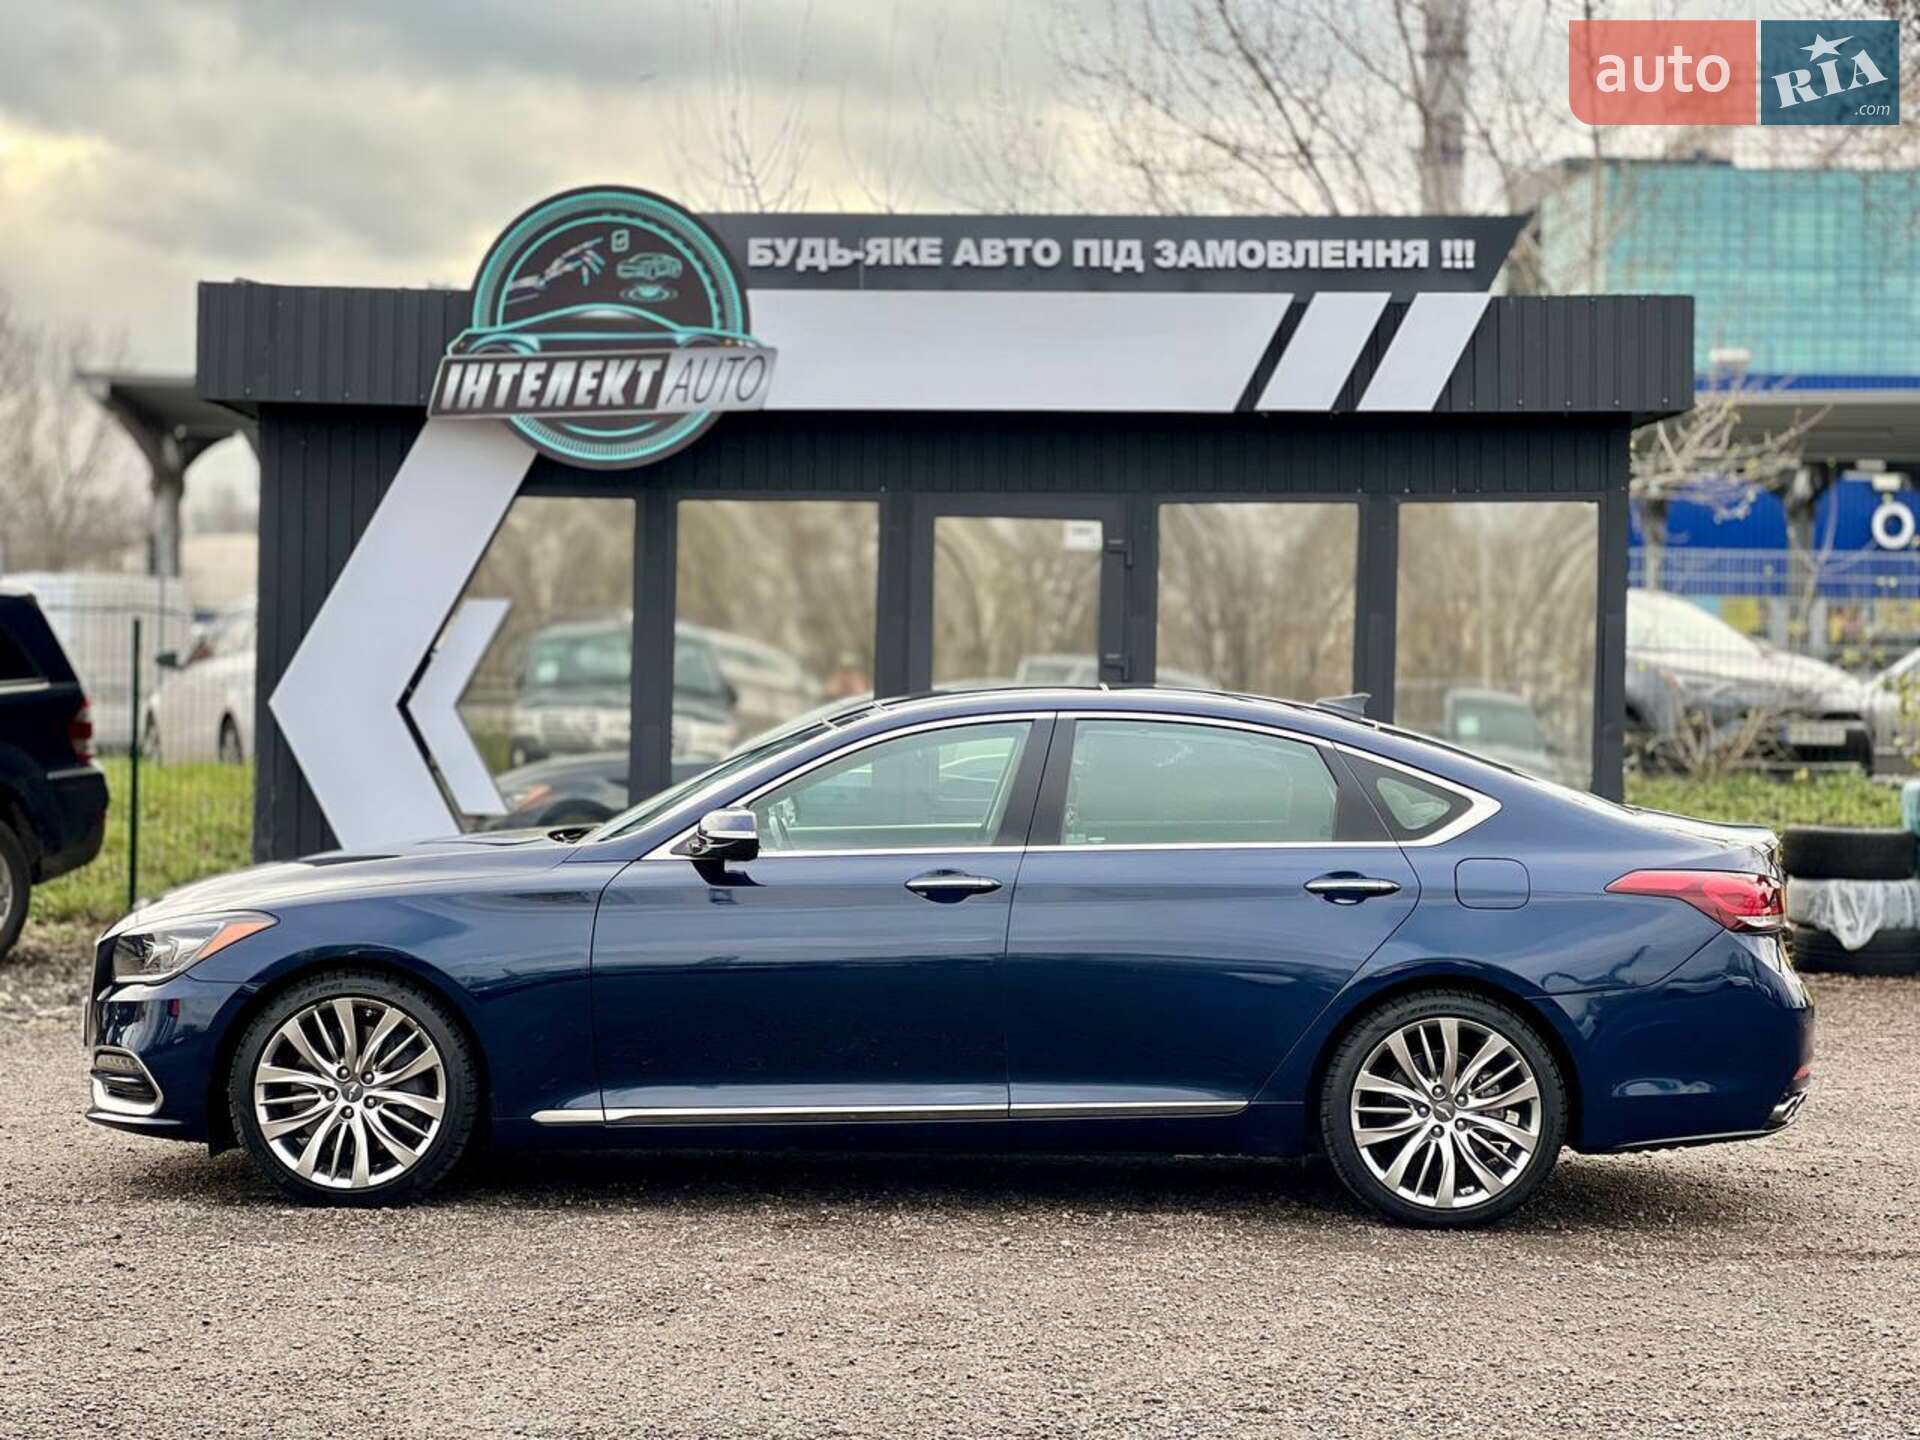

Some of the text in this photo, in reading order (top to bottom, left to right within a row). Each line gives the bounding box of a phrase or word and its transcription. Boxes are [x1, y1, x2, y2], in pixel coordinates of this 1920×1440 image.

[747, 236, 943, 272] БУДЬ-ЯКЕ
[951, 237, 1062, 268] АВТО
[1072, 238, 1145, 273] ПІД
[1153, 239, 1429, 269] ЗАМОВЛЕННЯ
[440, 354, 767, 410] ІНТЕЛЕКТ AUTO
